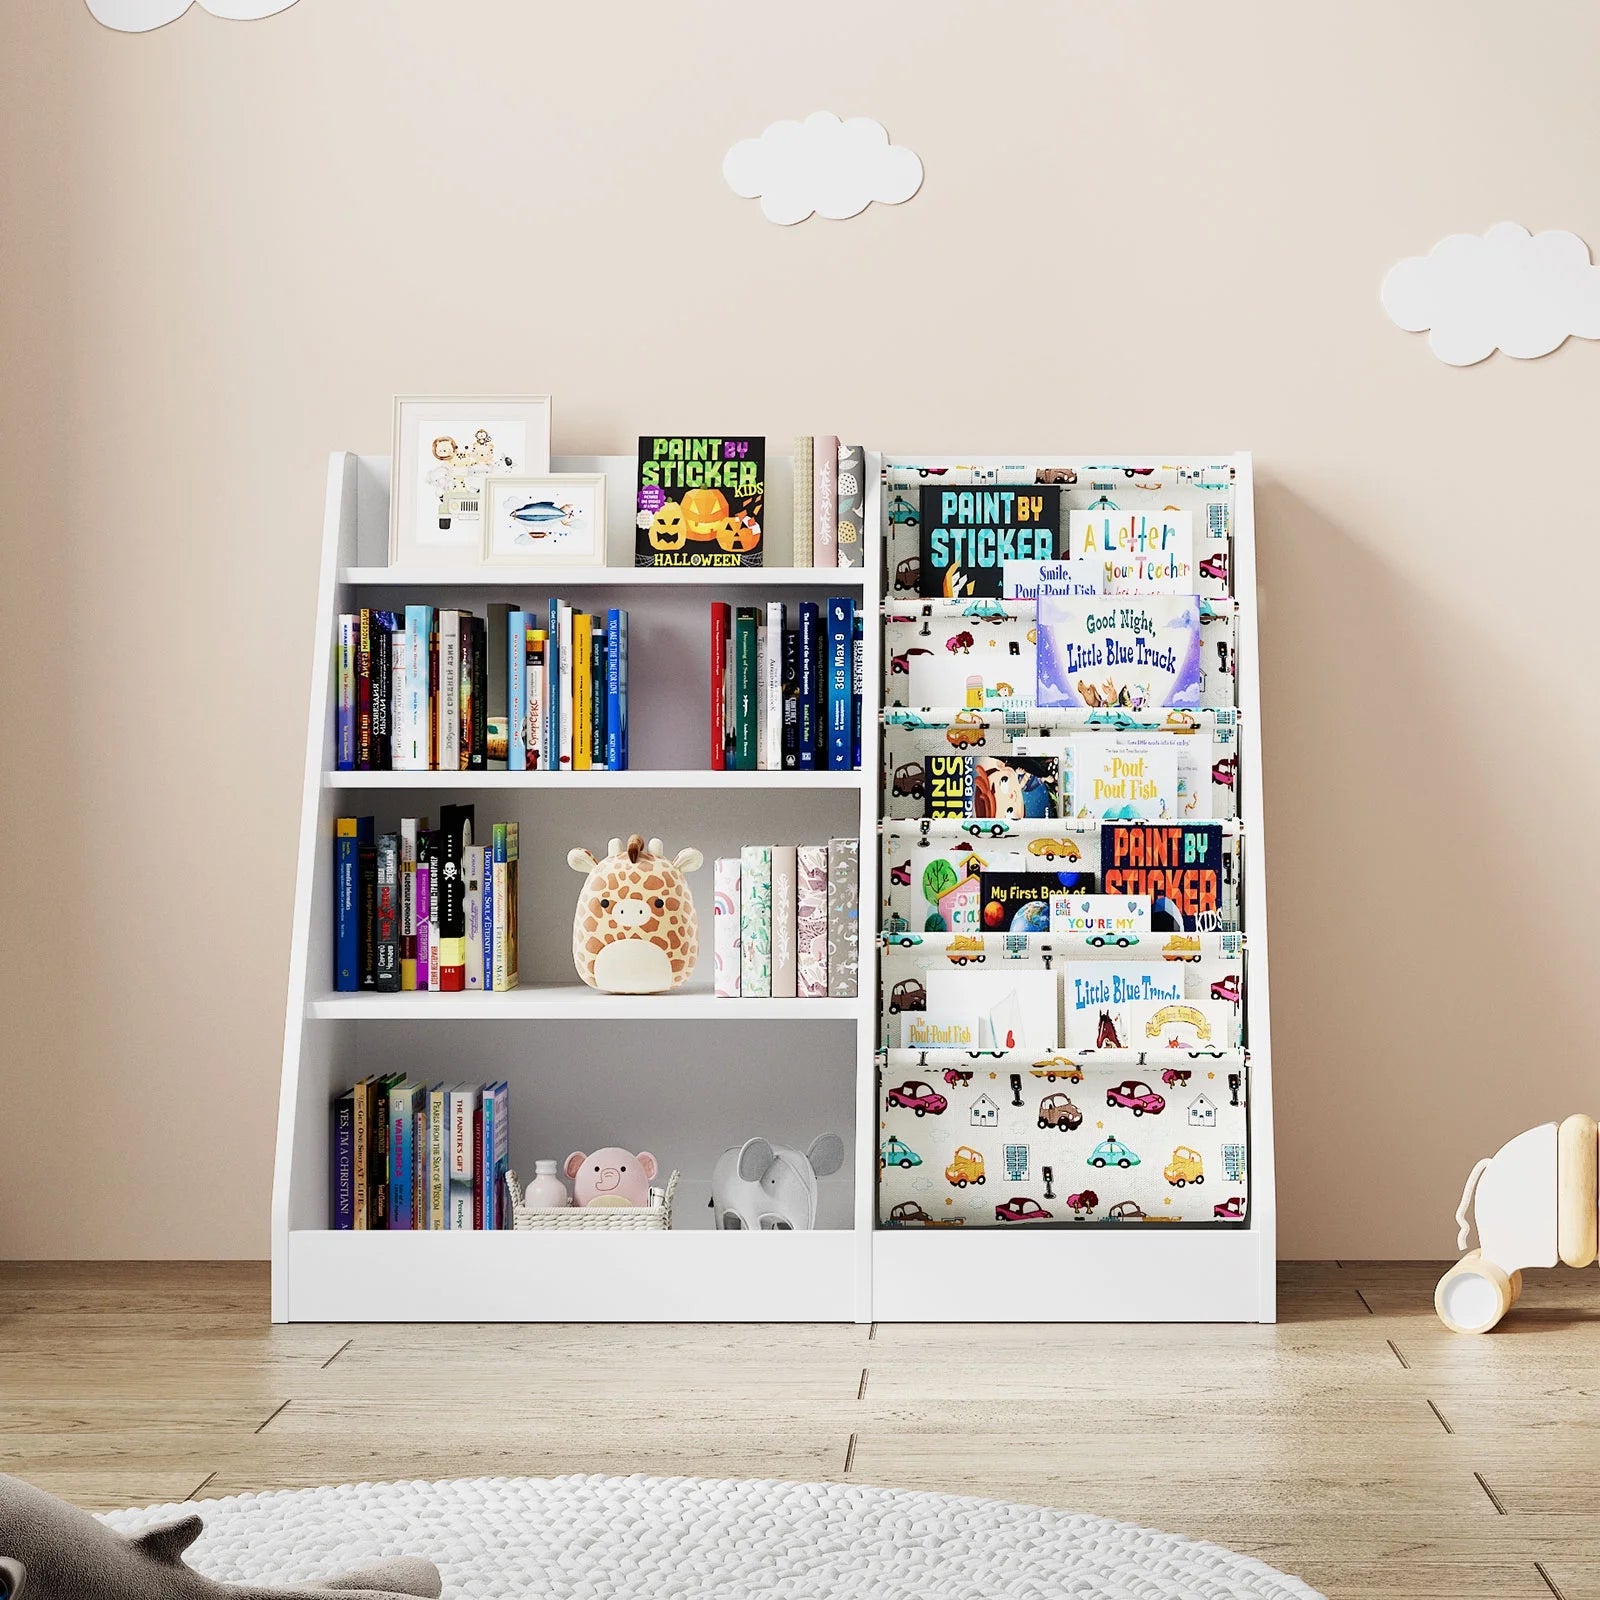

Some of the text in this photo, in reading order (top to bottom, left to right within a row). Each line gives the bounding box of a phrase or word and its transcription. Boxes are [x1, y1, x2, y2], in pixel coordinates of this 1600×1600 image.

[653, 439, 748, 461] PAINT BY
[642, 461, 758, 488] STICKER
[734, 482, 764, 498] KIDS
[942, 491, 1043, 524] PAINT BY
[1084, 516, 1175, 553] A Letter
[931, 529, 1053, 568] STICKER
[654, 554, 742, 567] HALLOWEEN
[1104, 553, 1191, 582] your Teacher
[1039, 564, 1072, 583] Smile,
[609, 620, 618, 631] YOU
[1086, 610, 1157, 638] Good Night,
[609, 631, 618, 640] ARE
[446, 643, 454, 666] АЗИИ
[609, 648, 618, 658] THE
[788, 634, 796, 680] HALO
[834, 633, 845, 690] 3ds Max 9
[1066, 637, 1177, 674] Little Blue Truck
[360, 652, 370, 678] Диета
[609, 659, 618, 671] TIME
[609, 671, 618, 682] FOR
[609, 682, 618, 694] LOVE
[528, 699, 540, 746] СуперСЕКС
[965, 757, 973, 797] BOYS
[1093, 779, 1158, 800] Pout Fish
[1113, 828, 1209, 867] PAINT BY
[484, 851, 492, 870] BODY
[345, 863, 353, 887] Biomedical
[345, 887, 353, 911] Informatics
[990, 886, 1086, 902] My First Book of
[1104, 869, 1218, 916] STICKER
[484, 896, 492, 916] SOUL
[1055, 901, 1071, 909] ERIC
[1068, 918, 1134, 929] YOU'RE MY
[1194, 908, 1223, 931] KIDS
[484, 921, 492, 955] ETERNITY
[496, 926, 504, 962] TREASURE
[377, 945, 386, 967] Сергей
[385, 945, 394, 970] Чекмаев
[496, 964, 504, 986] MAPS
[1074, 978, 1110, 1010] Little
[1112, 975, 1141, 1004] Blue
[916, 1016, 926, 1027] The
[909, 1024, 971, 1044] Pout-Pout Fish
[339, 1108, 349, 1129] YES,
[433, 1101, 442, 1124] PEARLS
[339, 1131, 349, 1146] I'M
[433, 1124, 442, 1141] FROM
[339, 1147, 349, 1155] A
[433, 1143, 442, 1155] THE
[357, 1166, 364, 1178] AT
[433, 1156, 442, 1173] SEAT
[339, 1156, 349, 1214] CHRISTIAN!
[433, 1173, 442, 1182] OF
[433, 1183, 442, 1210] WISDOM
[456, 1199, 464, 1229] Penelope
